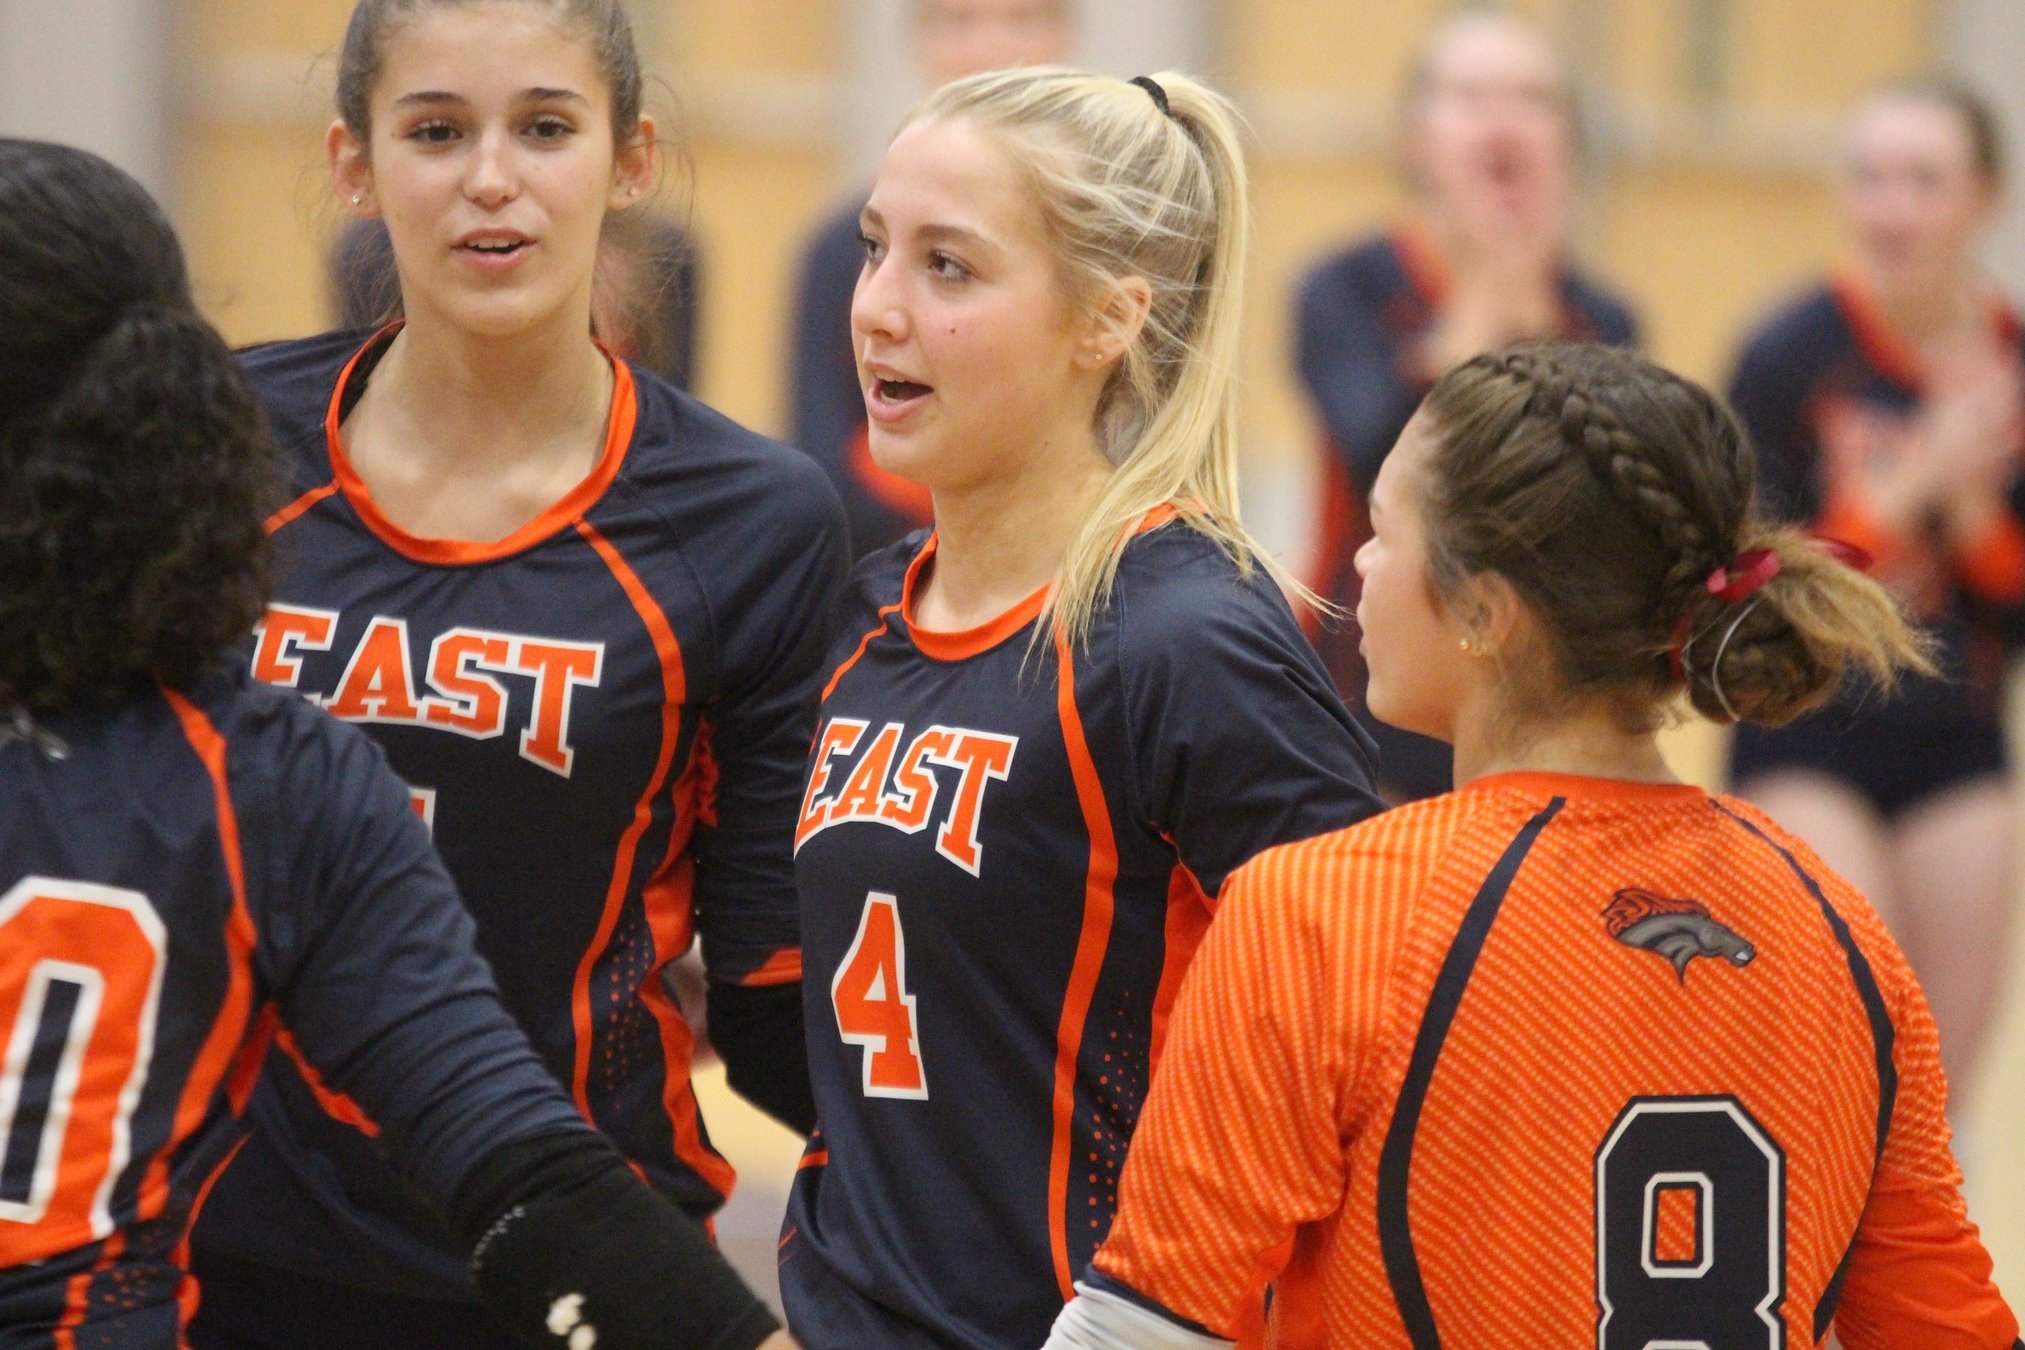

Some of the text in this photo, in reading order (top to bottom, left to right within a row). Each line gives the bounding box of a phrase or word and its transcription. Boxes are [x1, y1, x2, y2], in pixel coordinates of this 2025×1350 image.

[252, 602, 606, 780] EAST
[793, 717, 1019, 879] EAST
[831, 891, 929, 1101] 4
[1593, 1094, 1786, 1350] 8
